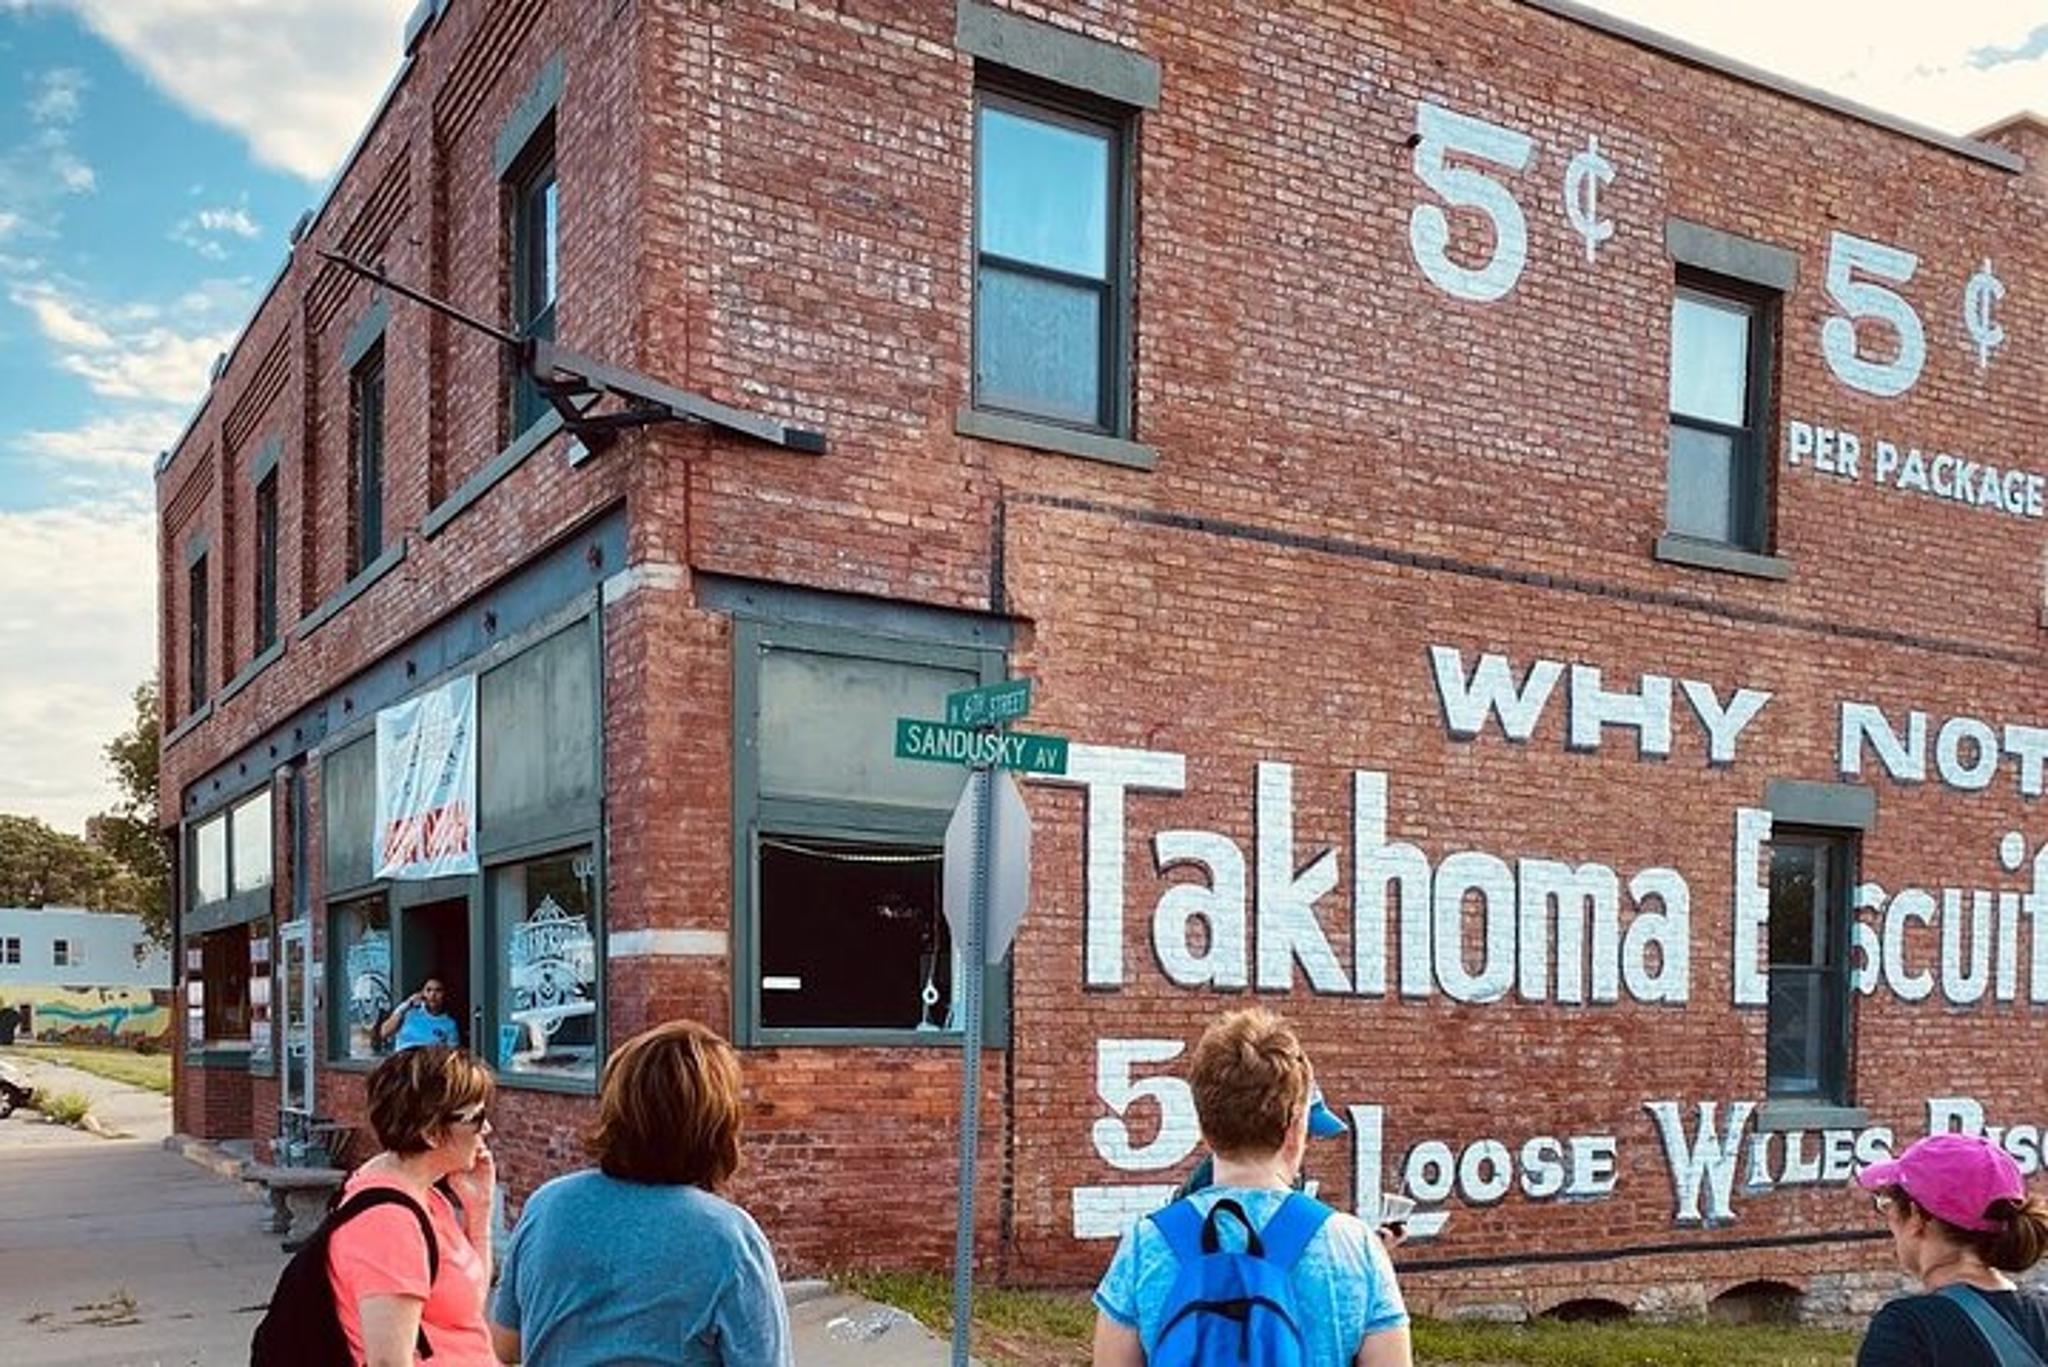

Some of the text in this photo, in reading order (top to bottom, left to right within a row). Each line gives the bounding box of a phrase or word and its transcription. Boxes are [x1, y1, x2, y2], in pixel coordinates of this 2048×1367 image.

[1790, 420, 2045, 516] PER PACKAGE
[905, 725, 1058, 769] SANDUSKY AV
[990, 689, 1026, 722] STREET
[1431, 646, 2048, 795] WHY NOT
[1028, 743, 1691, 1003] Takhoma
[1348, 1105, 1617, 1238] LOOSE
[1644, 1101, 1894, 1225] WILES
